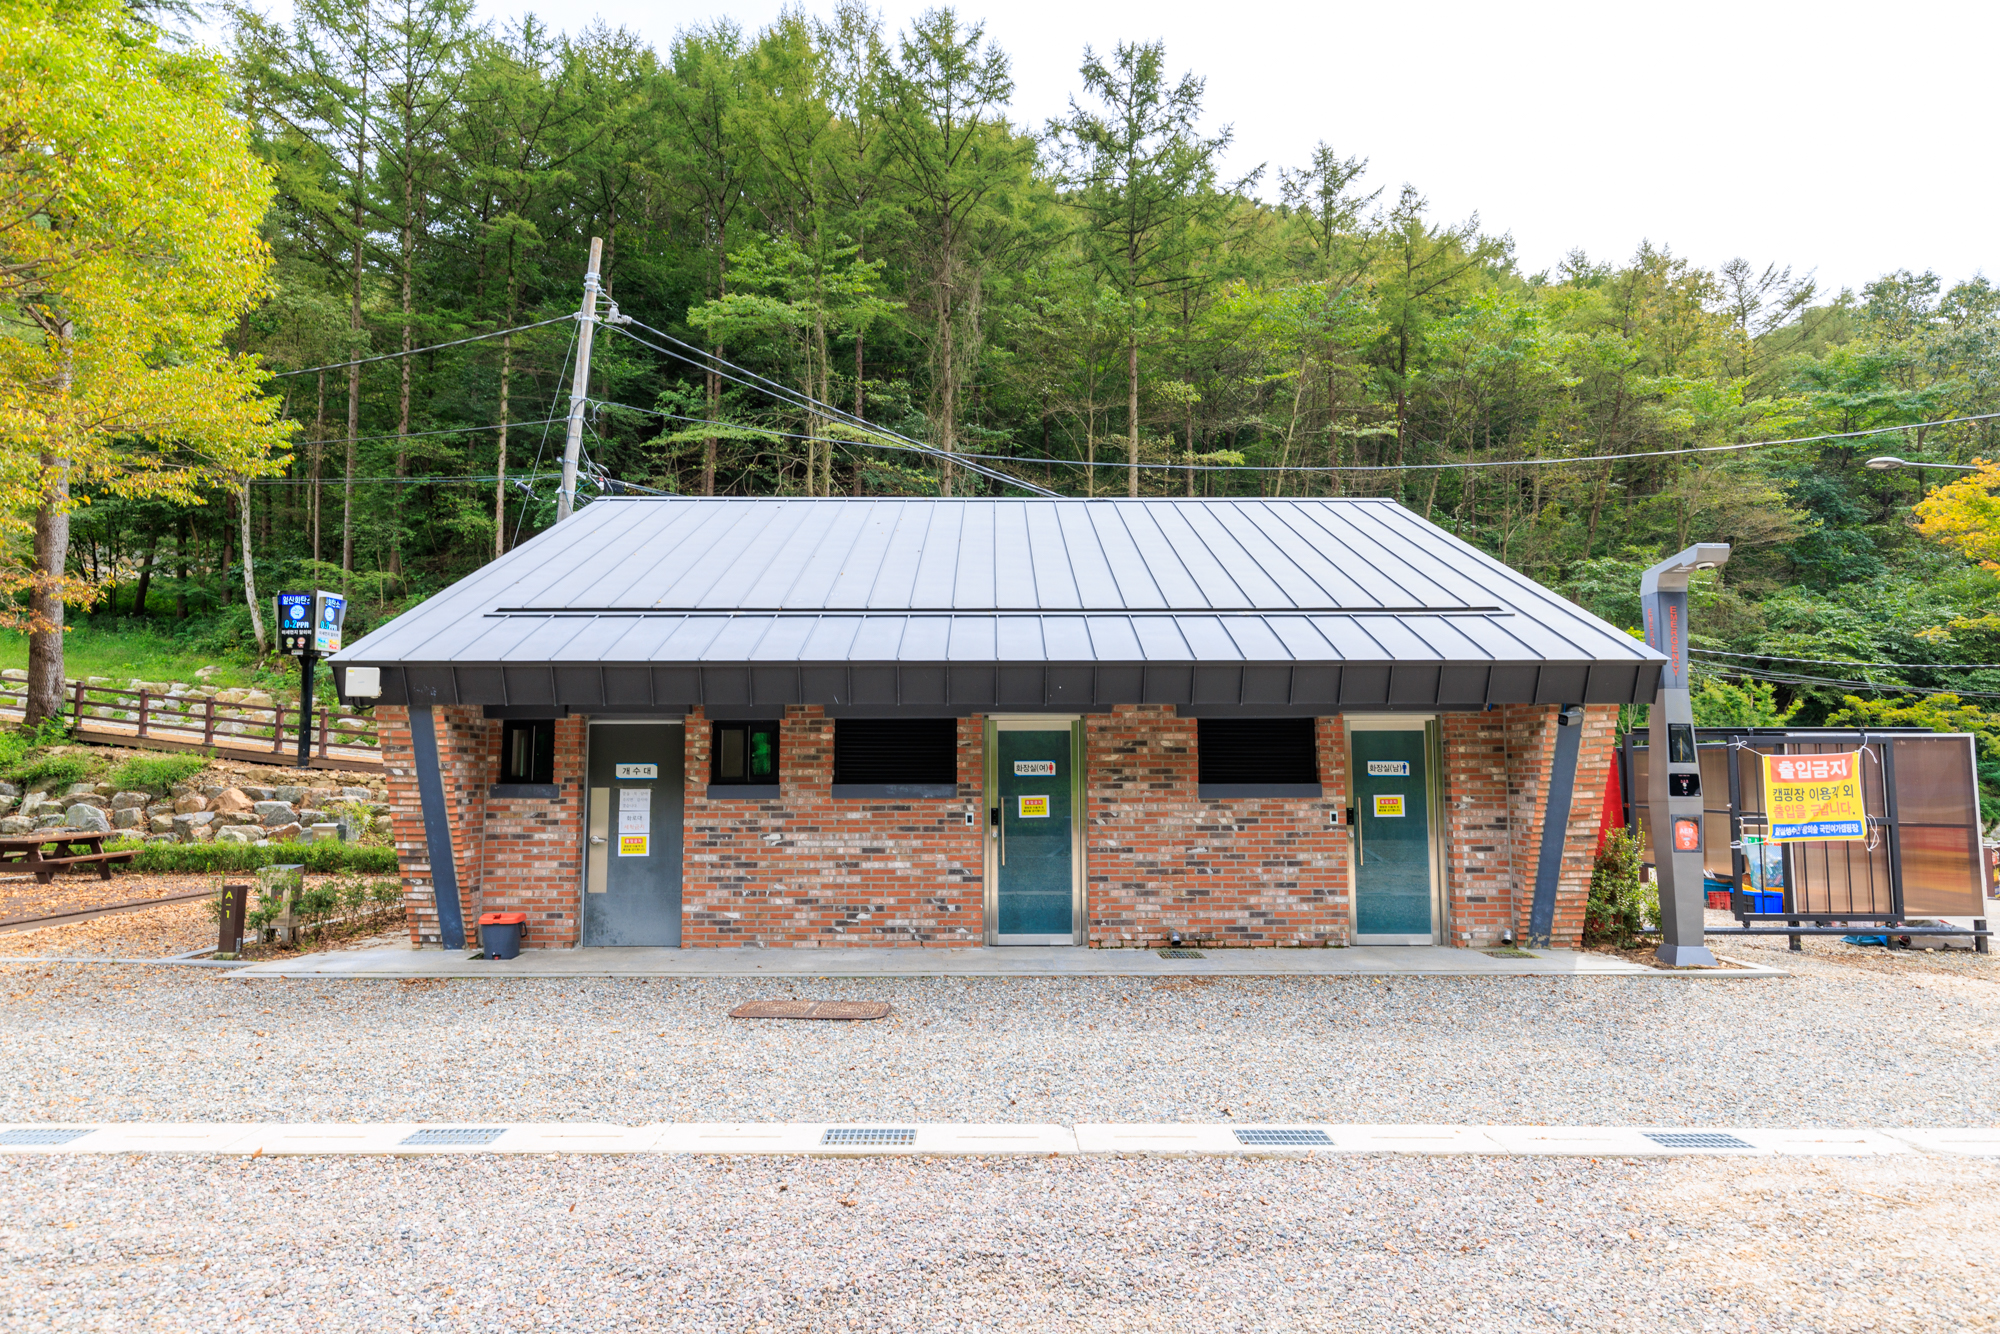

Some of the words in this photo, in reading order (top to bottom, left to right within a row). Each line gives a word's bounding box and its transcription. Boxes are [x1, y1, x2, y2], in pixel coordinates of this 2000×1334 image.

[1647, 608, 1656, 649] EMERG
[1669, 606, 1680, 676] EMERGENCY
[1016, 763, 1049, 773] 화장실(여)
[1369, 763, 1402, 773] 화장실(남)
[1778, 759, 1847, 779] 출입금지
[1773, 787, 1805, 802] 캠핑장
[1843, 784, 1854, 798] 외
[1773, 804, 1806, 819] 출입을
[1819, 823, 1859, 834] 국민여가캠핑장
